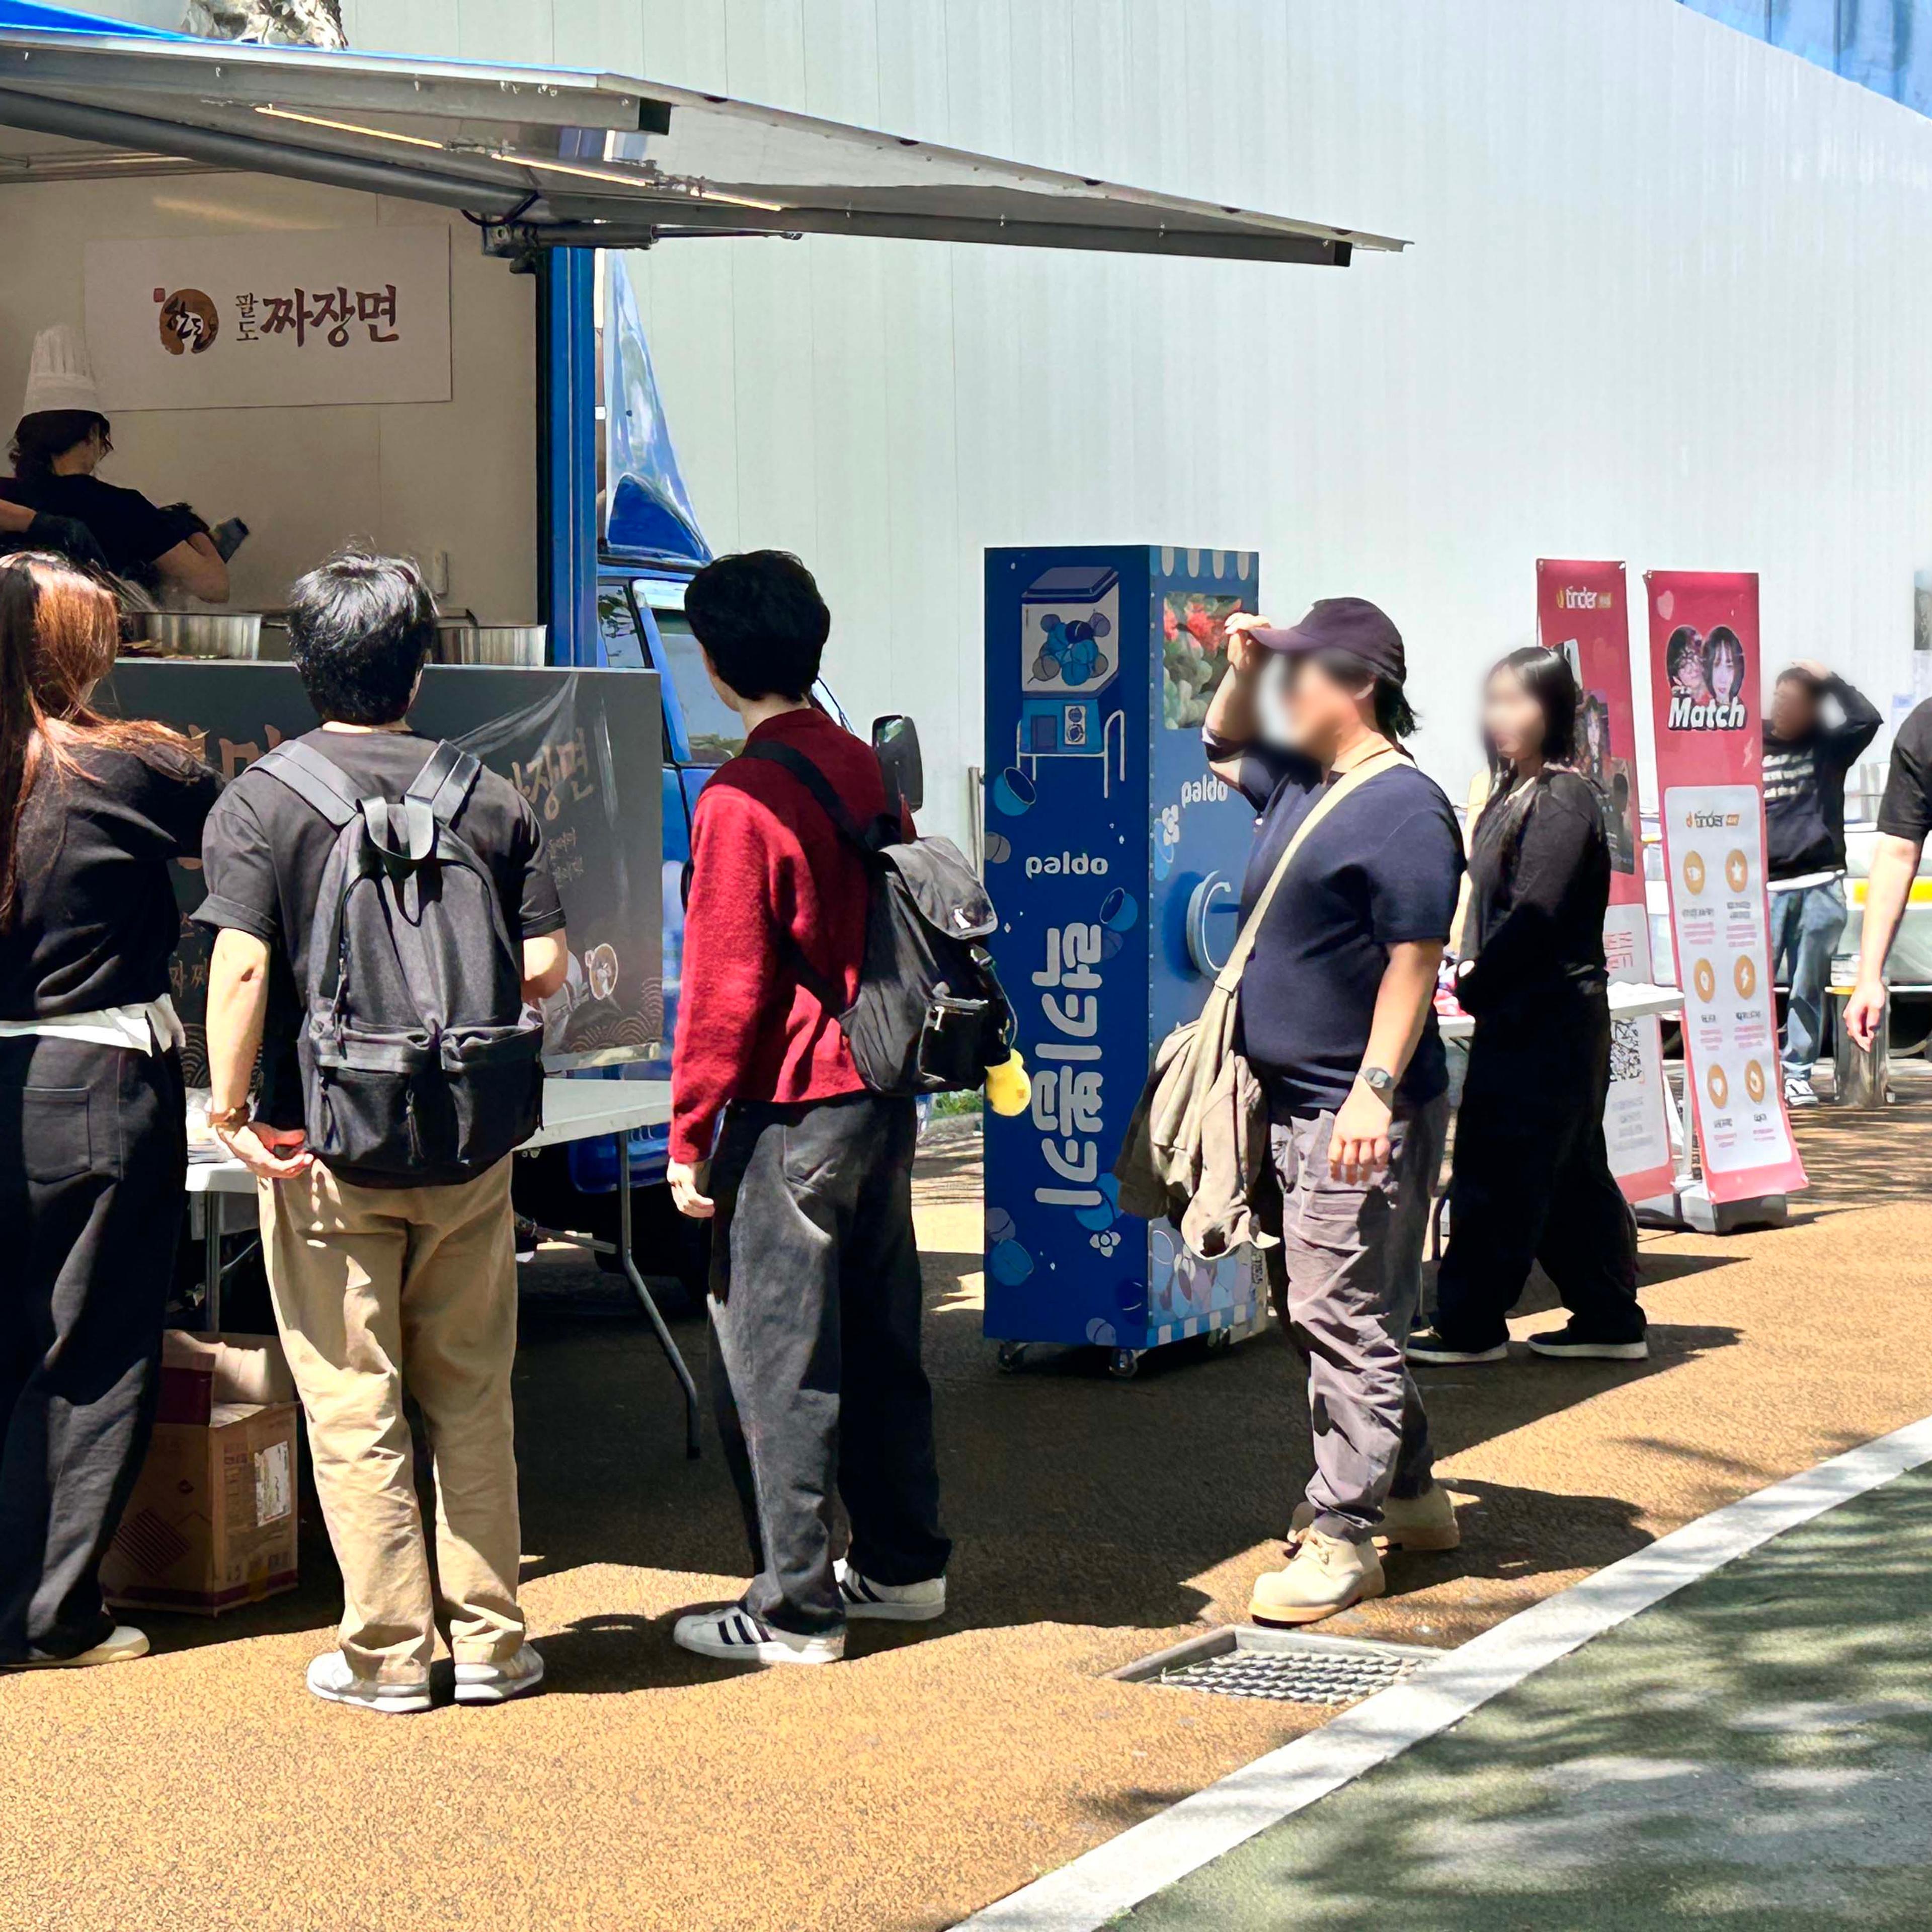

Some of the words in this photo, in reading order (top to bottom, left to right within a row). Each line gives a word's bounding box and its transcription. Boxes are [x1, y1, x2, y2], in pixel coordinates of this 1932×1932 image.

[235, 292, 259, 341] 팔도
[260, 284, 399, 348] 짜장면
[1668, 695, 1746, 730] Match
[1181, 778, 1228, 808] paldo
[1025, 851, 1108, 880] paldo
[1031, 922, 1103, 1206] 럭키뽑키
